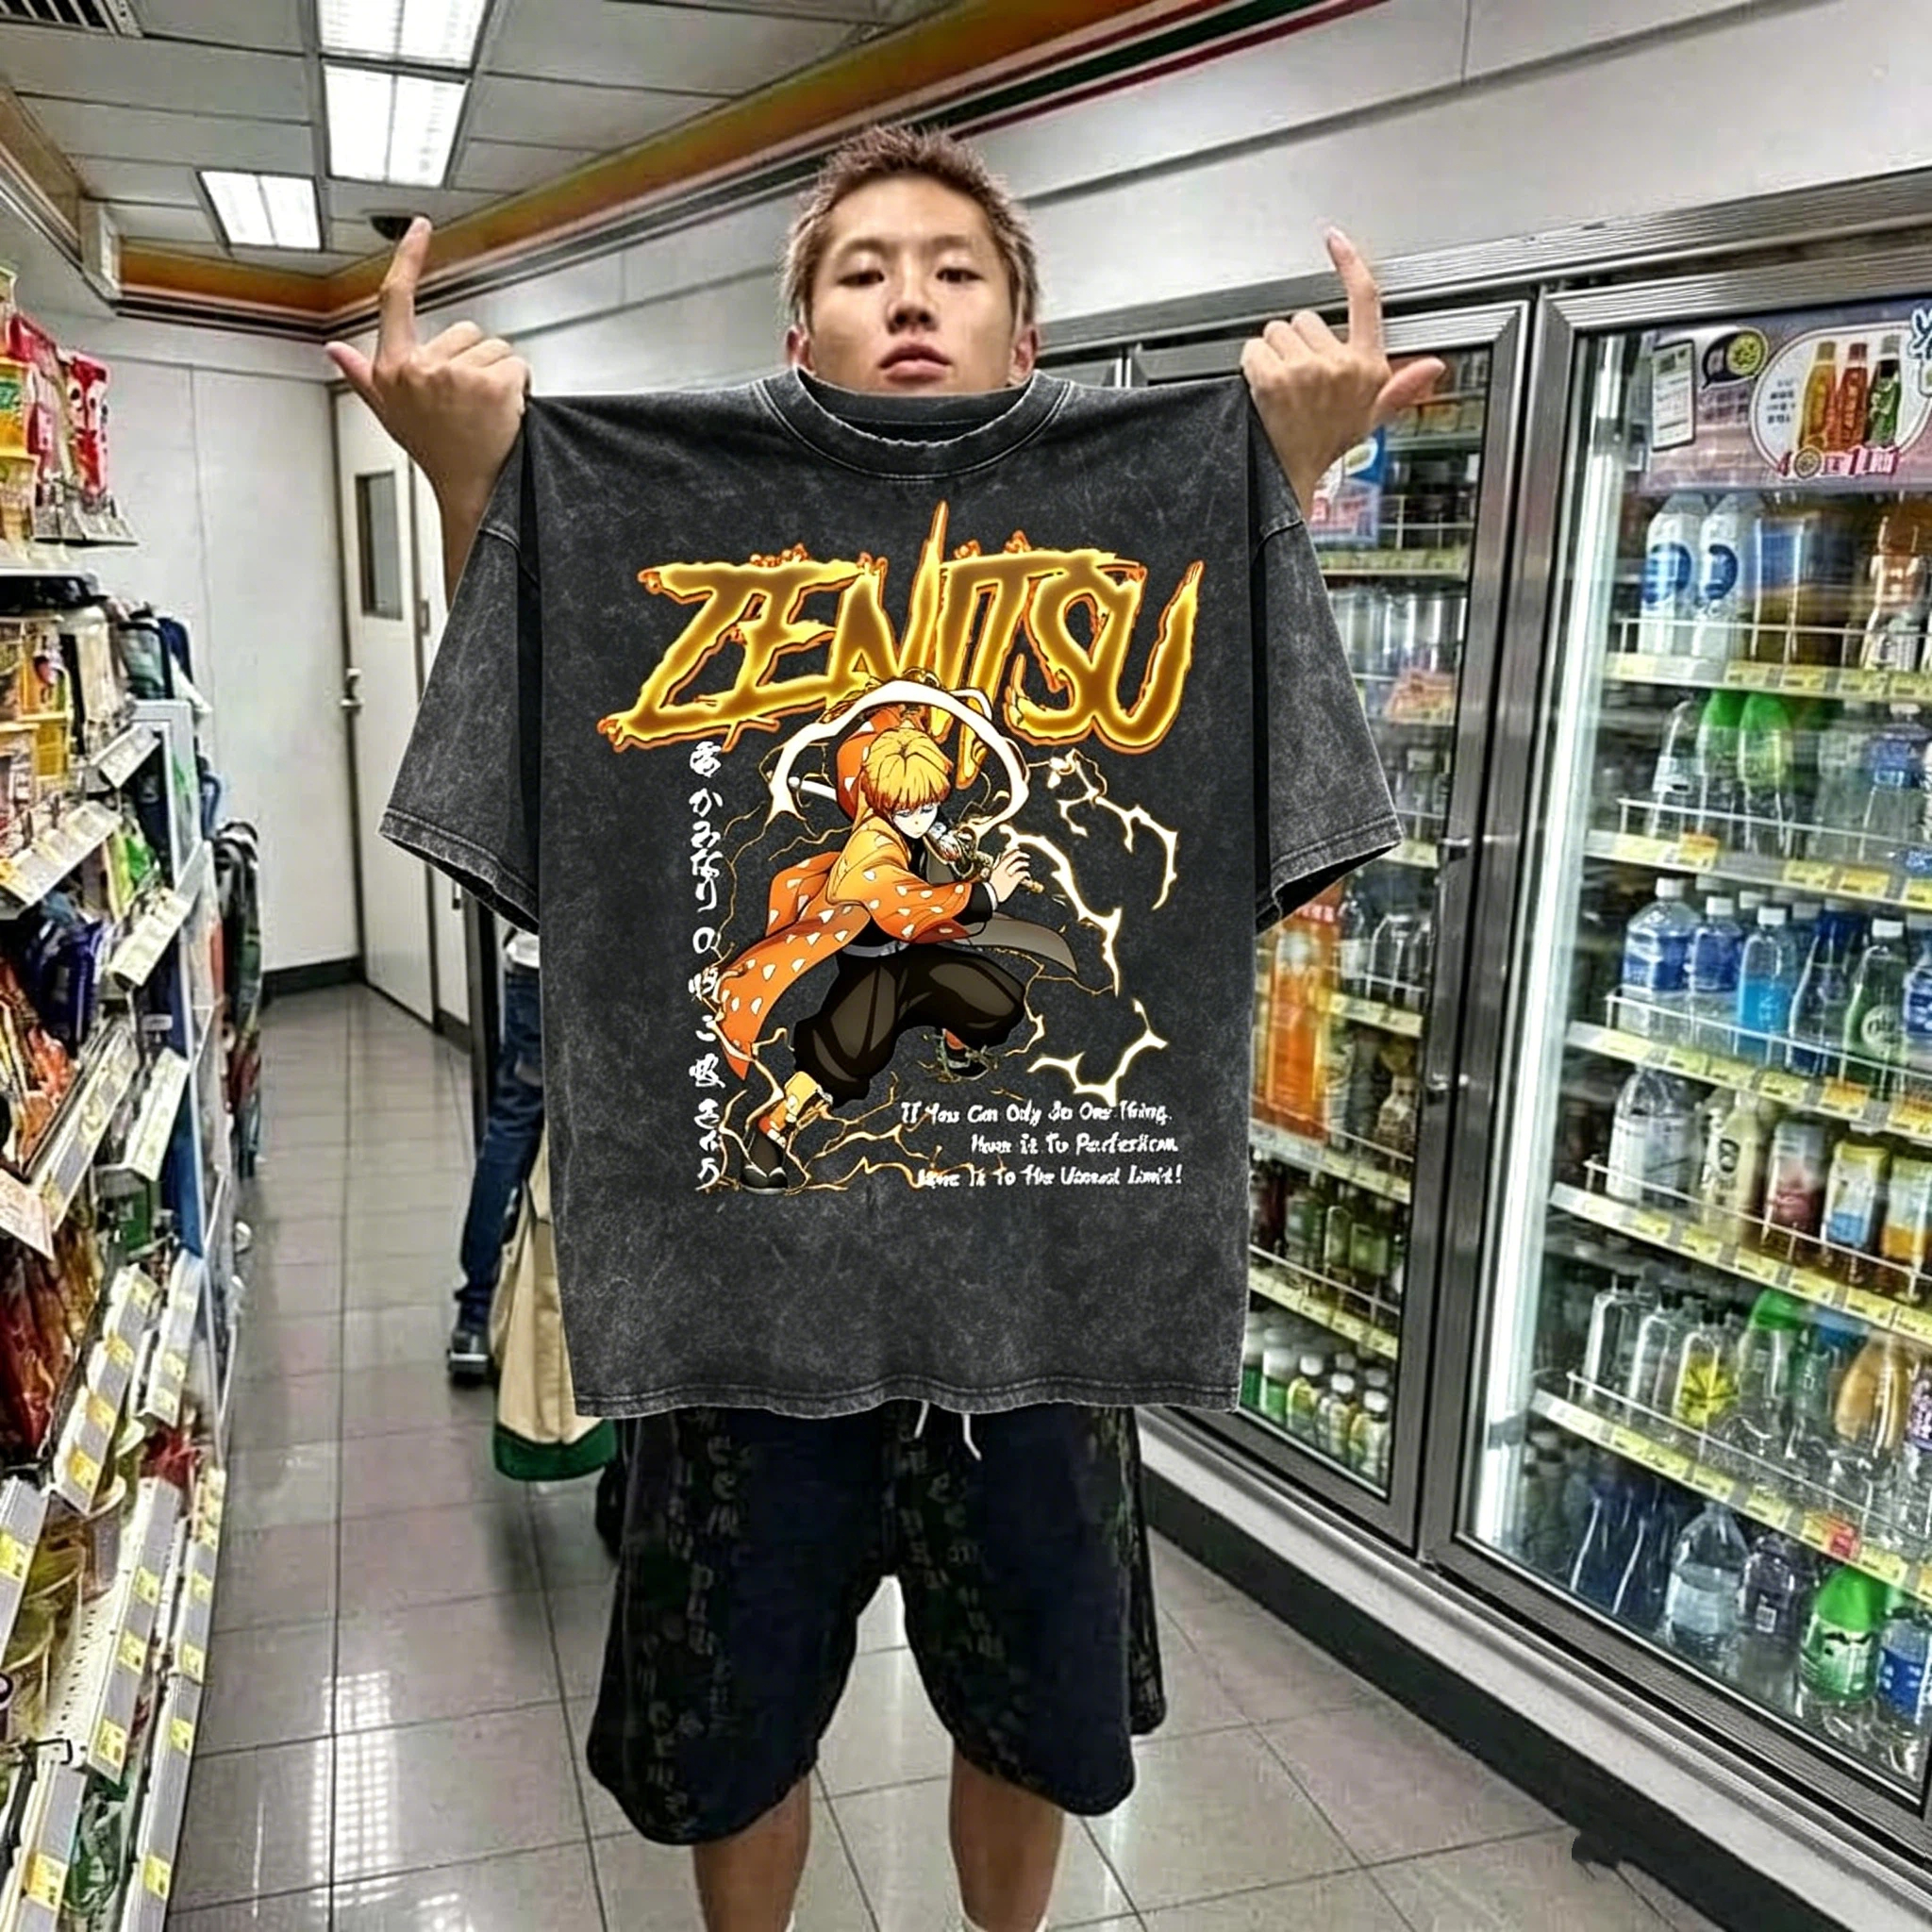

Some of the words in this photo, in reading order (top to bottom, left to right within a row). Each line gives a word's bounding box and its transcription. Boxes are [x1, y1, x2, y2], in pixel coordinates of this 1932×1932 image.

[597, 500, 1205, 788] ZENITSU
[924, 1102, 960, 1125] You
[967, 1105, 998, 1123] Can
[1079, 1102, 1112, 1121] One
